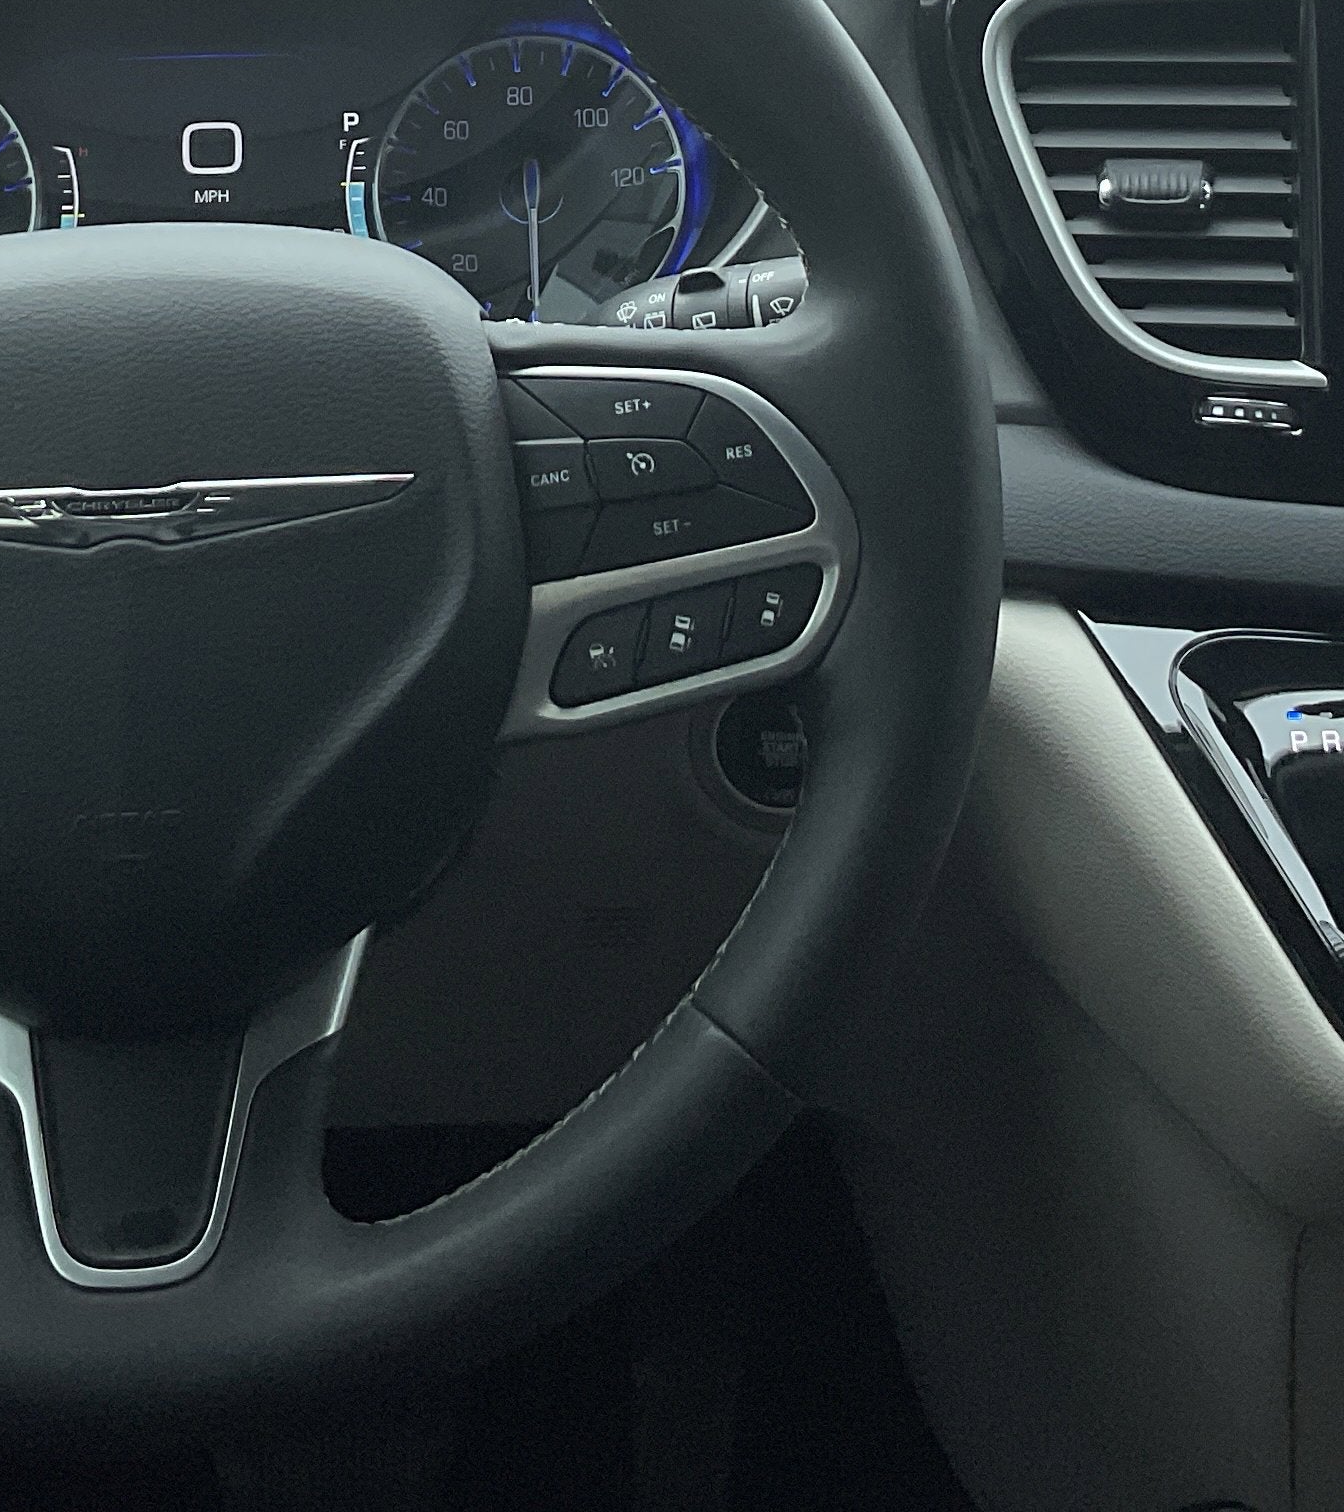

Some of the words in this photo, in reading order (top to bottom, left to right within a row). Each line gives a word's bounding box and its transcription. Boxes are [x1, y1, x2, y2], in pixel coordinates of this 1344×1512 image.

[506, 86, 533, 107] 80
[342, 112, 360, 132] P
[573, 107, 609, 129] 100
[443, 120, 469, 141] 60
[181, 120, 243, 175] 0
[609, 166, 645, 189] 120
[194, 189, 230, 204] MPH
[420, 187, 448, 208] 40
[451, 254, 478, 273] 20
[751, 271, 775, 283] OFF
[648, 292, 666, 305] ON
[725, 444, 753, 460] RES
[530, 469, 570, 487] CANC
